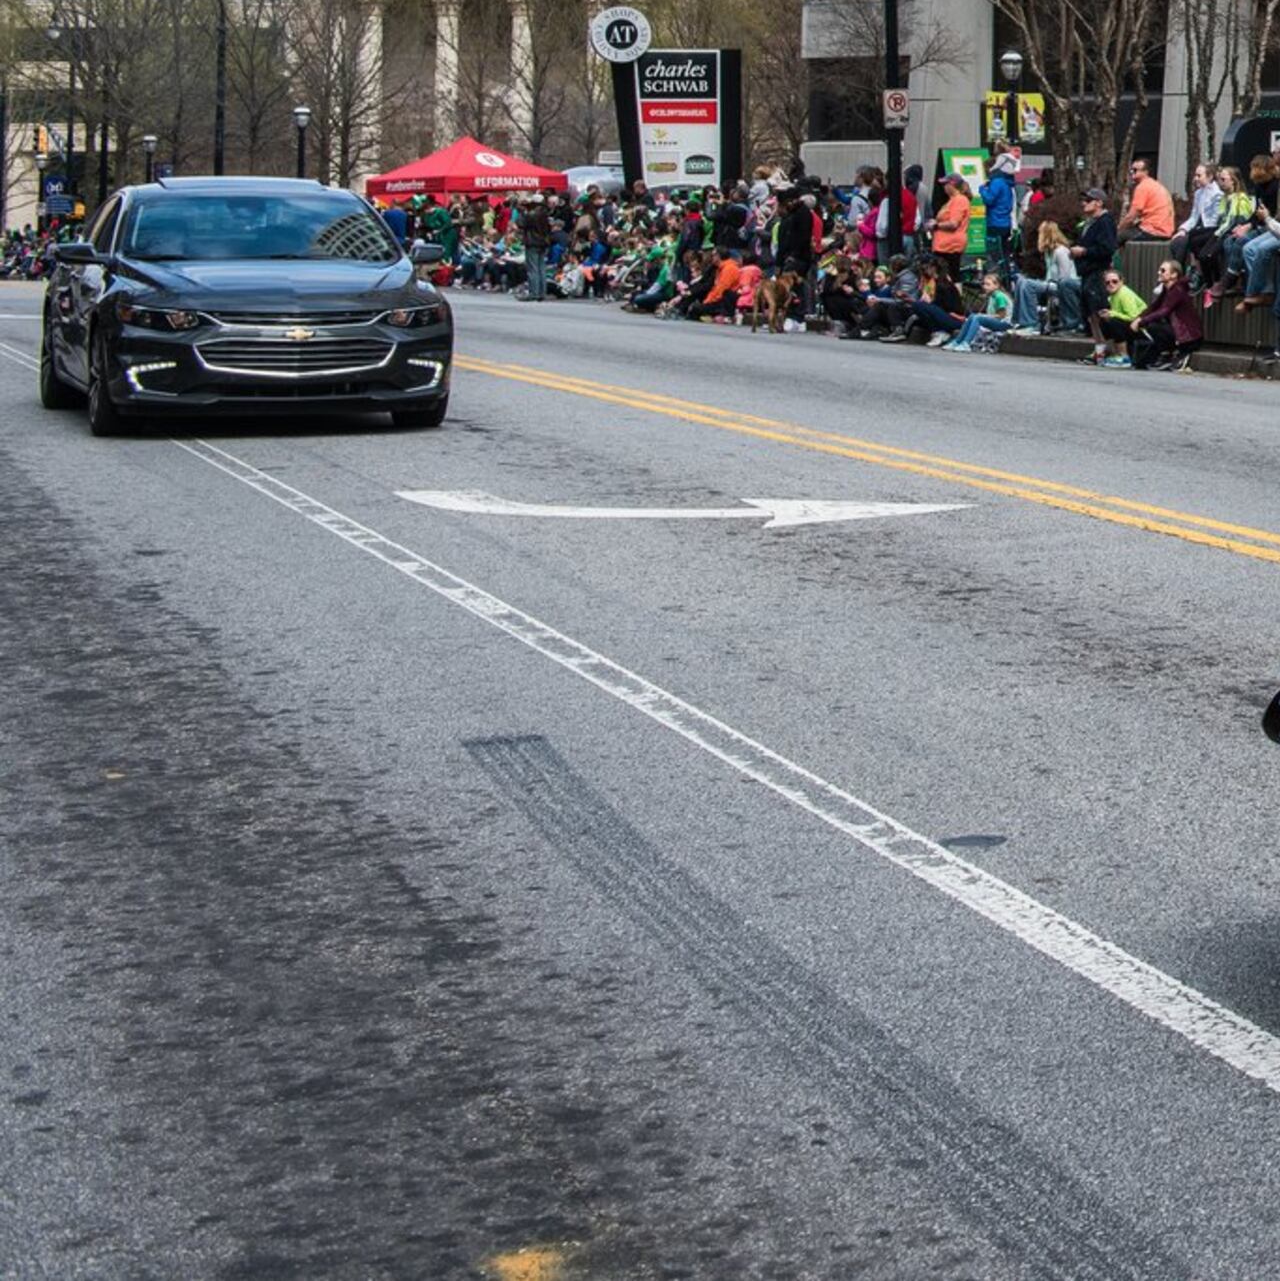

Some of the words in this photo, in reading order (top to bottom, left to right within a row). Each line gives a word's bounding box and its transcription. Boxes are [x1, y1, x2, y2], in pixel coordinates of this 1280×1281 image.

[609, 24, 635, 44] AT
[644, 59, 707, 77] charles
[643, 80, 709, 93] SCHWAB
[474, 175, 540, 188] REFORMATION
